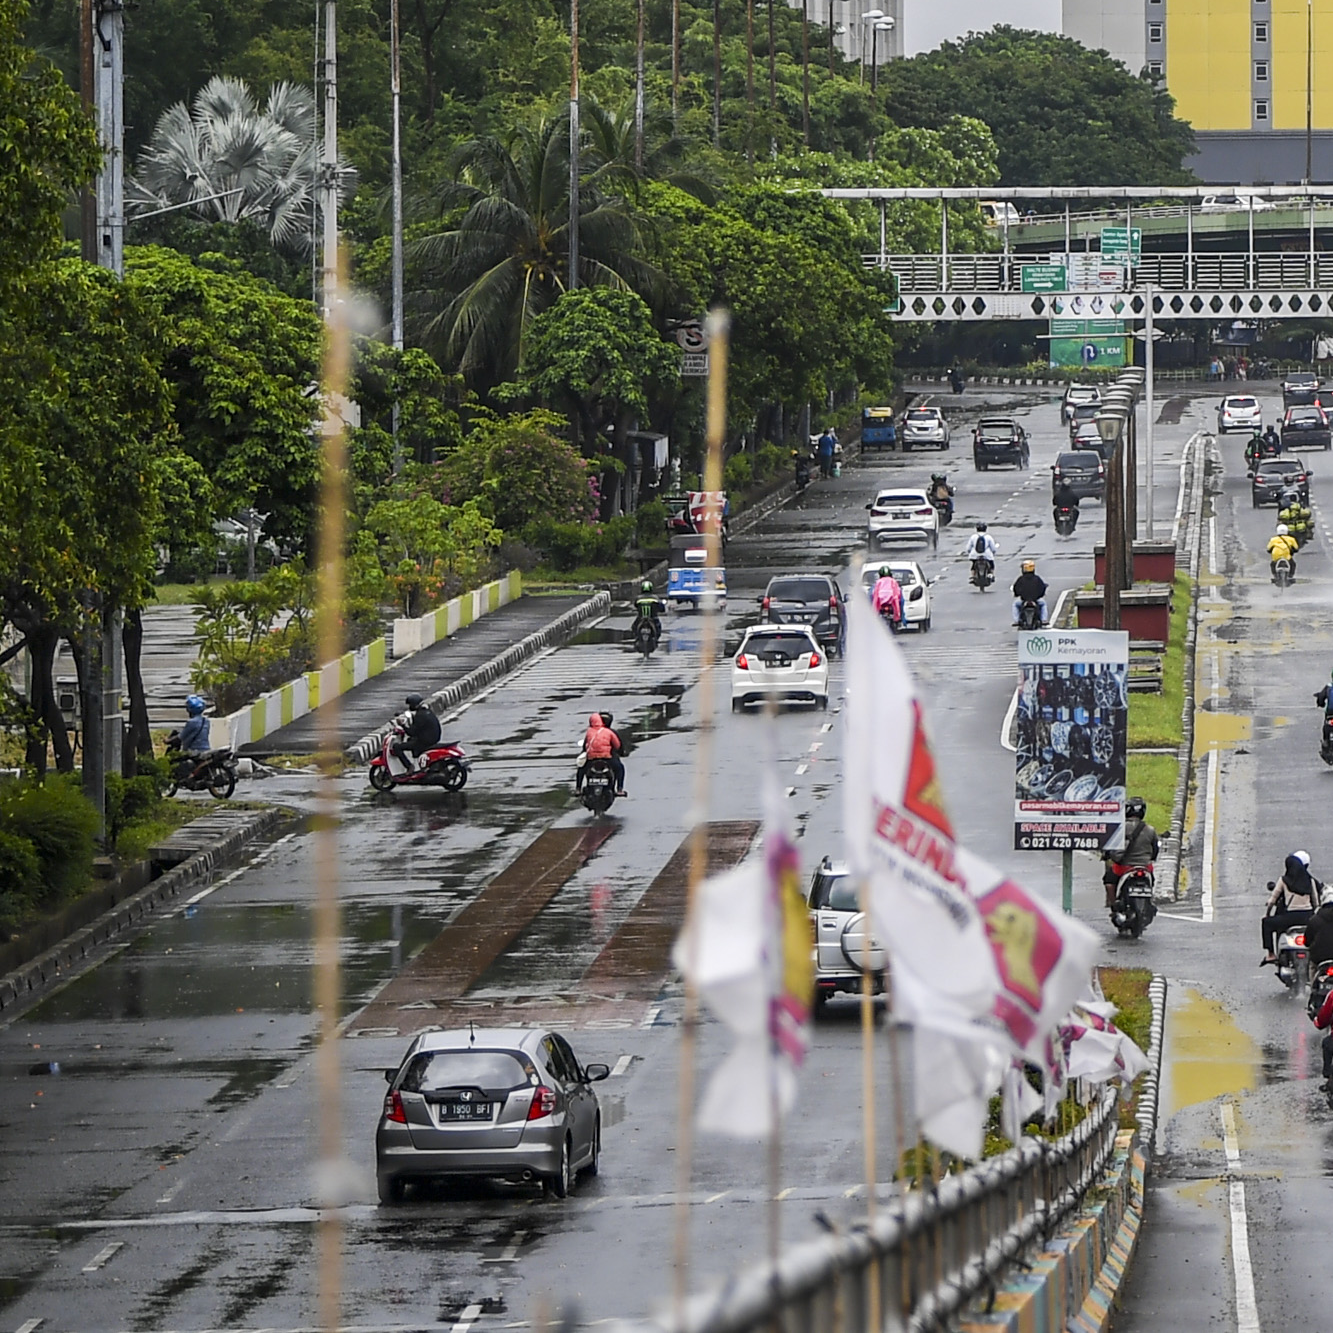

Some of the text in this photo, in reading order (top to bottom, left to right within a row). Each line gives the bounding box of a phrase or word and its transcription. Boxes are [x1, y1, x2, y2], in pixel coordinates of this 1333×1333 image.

[1107, 347, 1121, 355] KM
[1058, 638, 1077, 646] PPK
[1057, 647, 1107, 655] Kemayoran
[1021, 801, 1119, 810] pasarmobilkemayoran.com
[1020, 823, 1107, 833] SPACE AVAILABLE
[1032, 837, 1099, 848] 021 420 7688
[441, 1103, 490, 1115] B 1950 BFI
